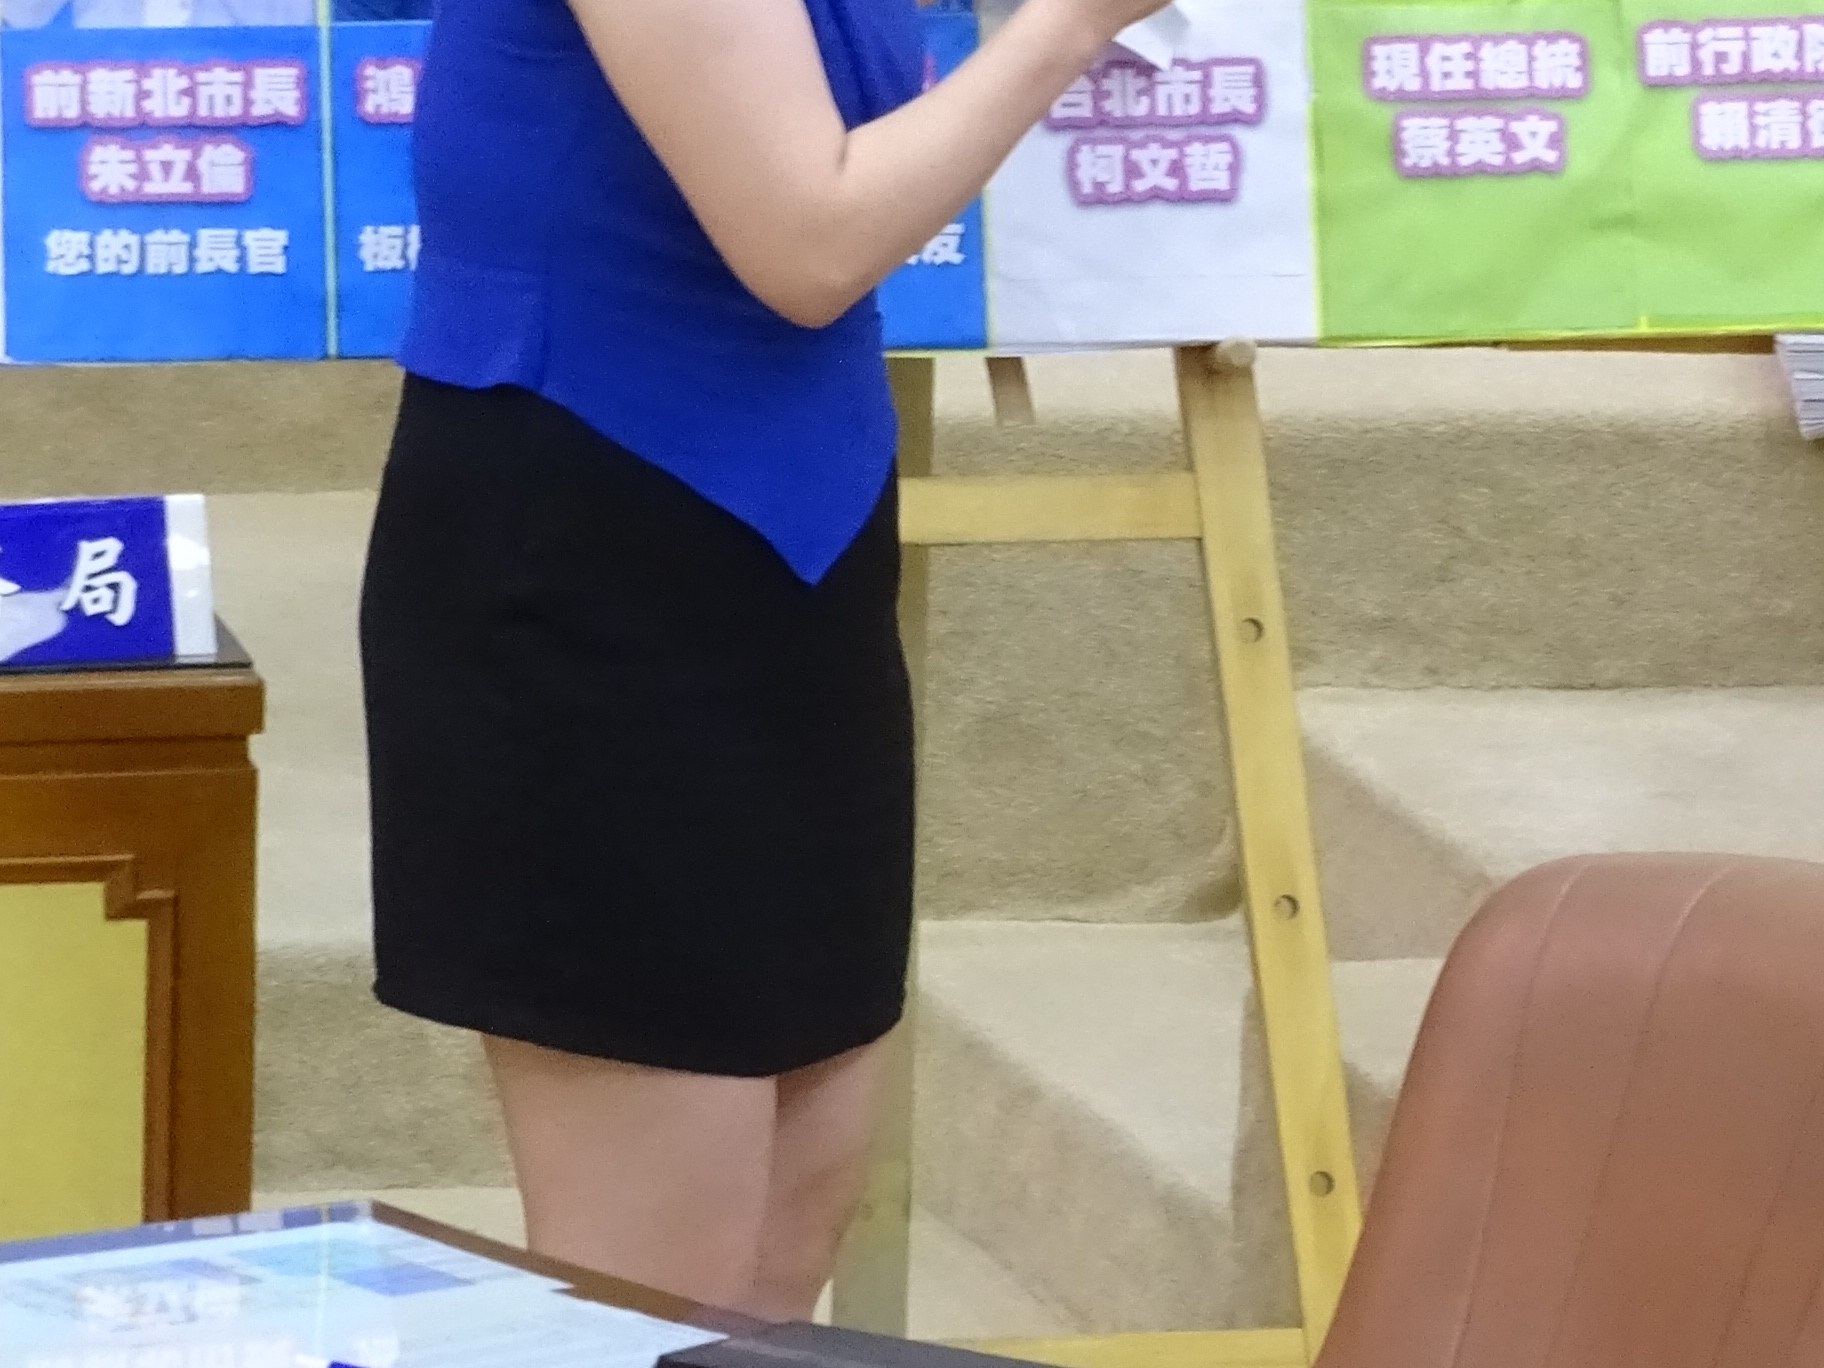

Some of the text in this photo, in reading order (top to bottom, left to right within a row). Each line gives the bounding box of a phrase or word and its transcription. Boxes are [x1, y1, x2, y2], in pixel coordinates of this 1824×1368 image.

[1370, 39, 1583, 92] 現任總統
[31, 66, 301, 118] 前新北市長
[1074, 140, 1233, 194] 柯文哲
[1401, 114, 1561, 168] 蔡英文
[87, 143, 247, 195] 朱立倫
[45, 227, 289, 275] 您的前長官
[358, 224, 421, 272] 板
